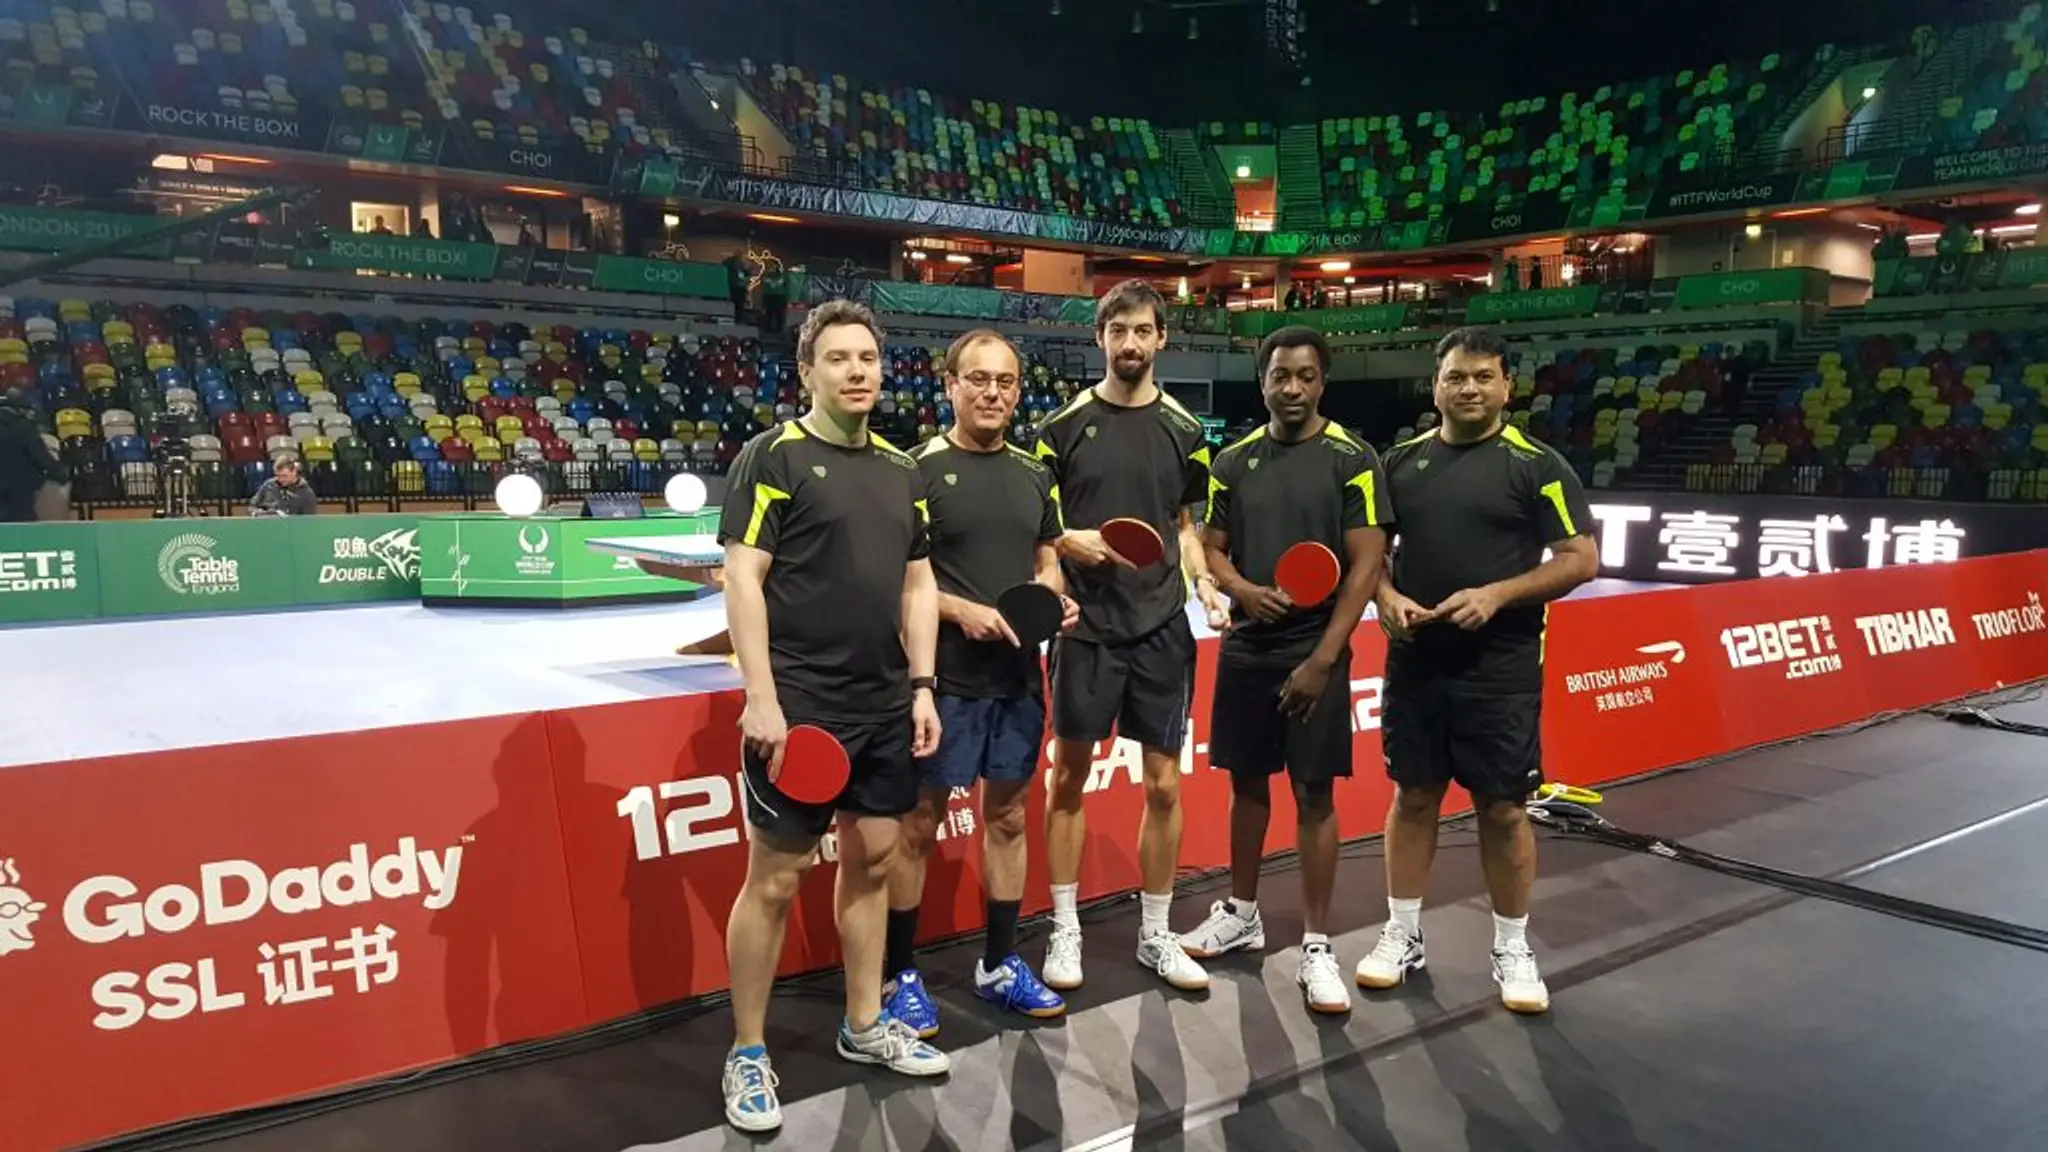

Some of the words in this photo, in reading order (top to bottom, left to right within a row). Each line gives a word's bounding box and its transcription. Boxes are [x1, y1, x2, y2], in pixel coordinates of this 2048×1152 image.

[148, 104, 208, 127] ROCK
[211, 112, 250, 131] THE
[254, 117, 299, 137] BOX!
[510, 150, 552, 168] CHO!
[1934, 148, 2000, 168] WELCOME
[2003, 146, 2021, 159] TO
[1669, 185, 1773, 208] #ITTFWorldCup
[1491, 213, 1522, 230] CHO!
[330, 240, 383, 258] ROCK
[387, 244, 421, 261] THE
[425, 248, 468, 265] BOX!
[644, 267, 684, 283] CHO!
[1720, 279, 1760, 296] CHO!
[187, 556, 239, 571] Table
[319, 565, 388, 583] DOUBLE
[179, 568, 240, 585] Tennis
[1855, 608, 1956, 656] TIBHAR
[1971, 605, 2046, 640] TRIOFLOR
[1720, 616, 1821, 669] 12BET
[1565, 667, 1618, 693] BRITISH
[1619, 660, 1668, 684] AIRWAYS
[63, 837, 463, 943] GoDaddy
[91, 958, 246, 1030] SSL
[257, 924, 400, 1006] 证书
